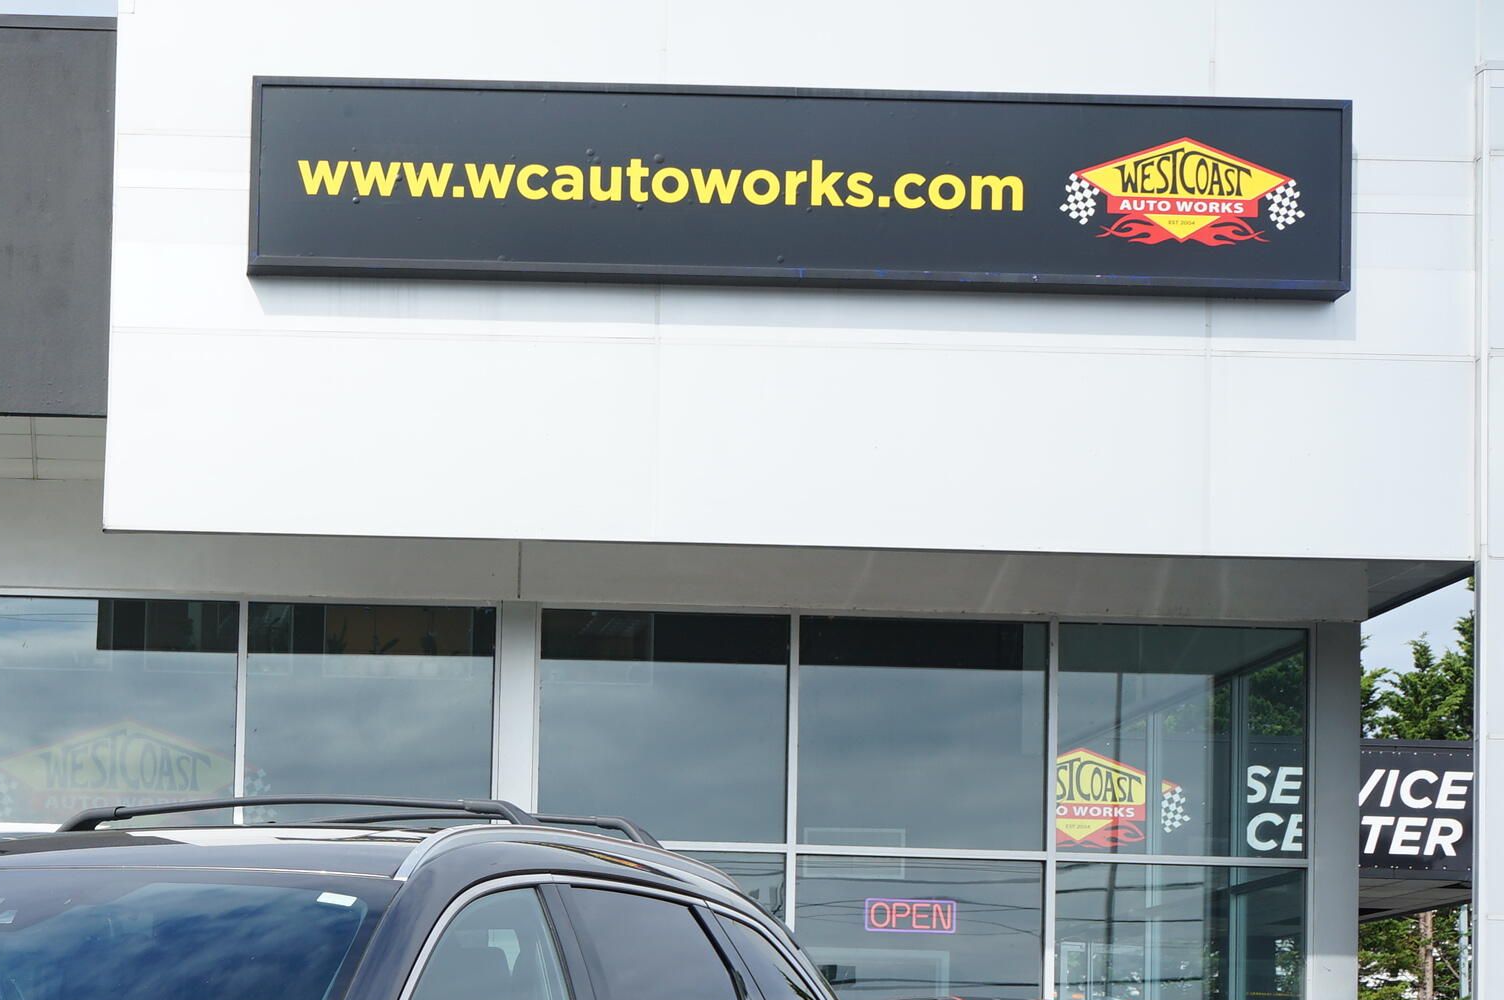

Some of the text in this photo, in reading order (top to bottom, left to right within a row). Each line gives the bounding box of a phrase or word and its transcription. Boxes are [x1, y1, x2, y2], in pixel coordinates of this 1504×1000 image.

[298, 157, 1024, 212] www.wcautoworks.com
[1120, 199, 1244, 214] AUTO WORKS
[1073, 806, 1135, 818] WORKS
[870, 901, 952, 930] OPEN
